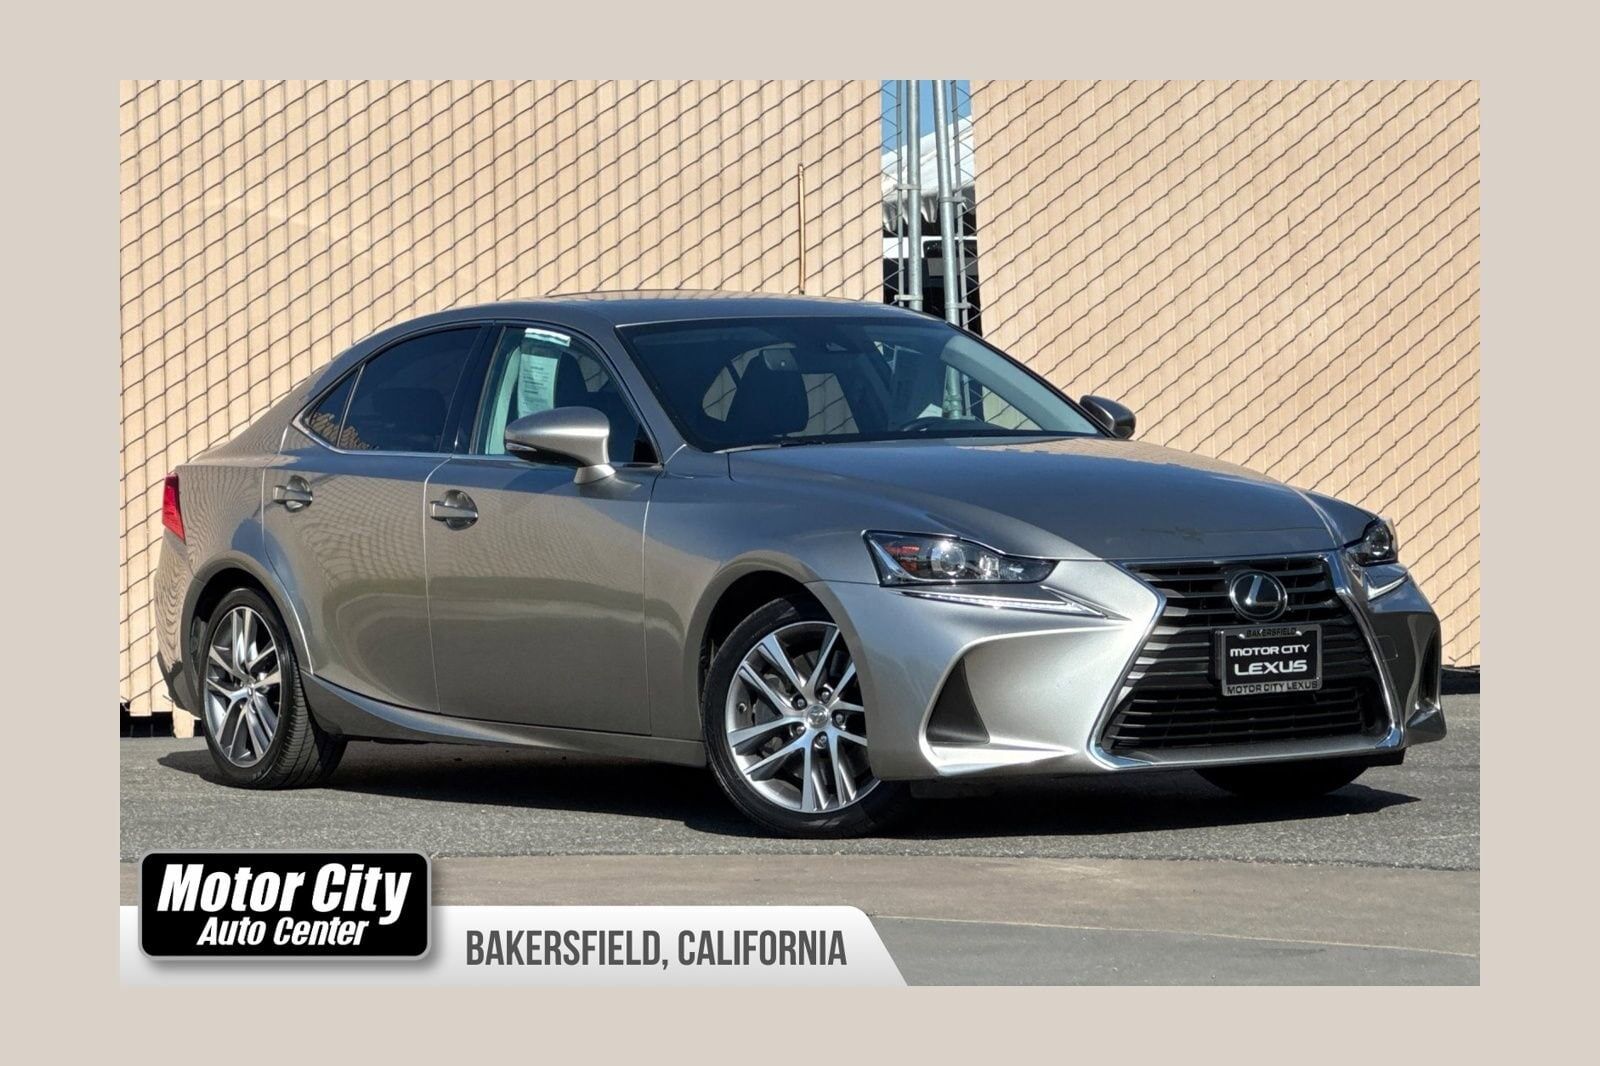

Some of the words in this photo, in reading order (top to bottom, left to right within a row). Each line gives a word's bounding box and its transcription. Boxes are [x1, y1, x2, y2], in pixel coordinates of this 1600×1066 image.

[1246, 627, 1297, 637] BAKERSFIELD
[1281, 644, 1310, 654] CITY
[1234, 659, 1308, 676] LEXUS
[1227, 685, 1262, 695] MOTOR
[1263, 683, 1285, 692] CITY
[1286, 680, 1318, 690] LEXUS
